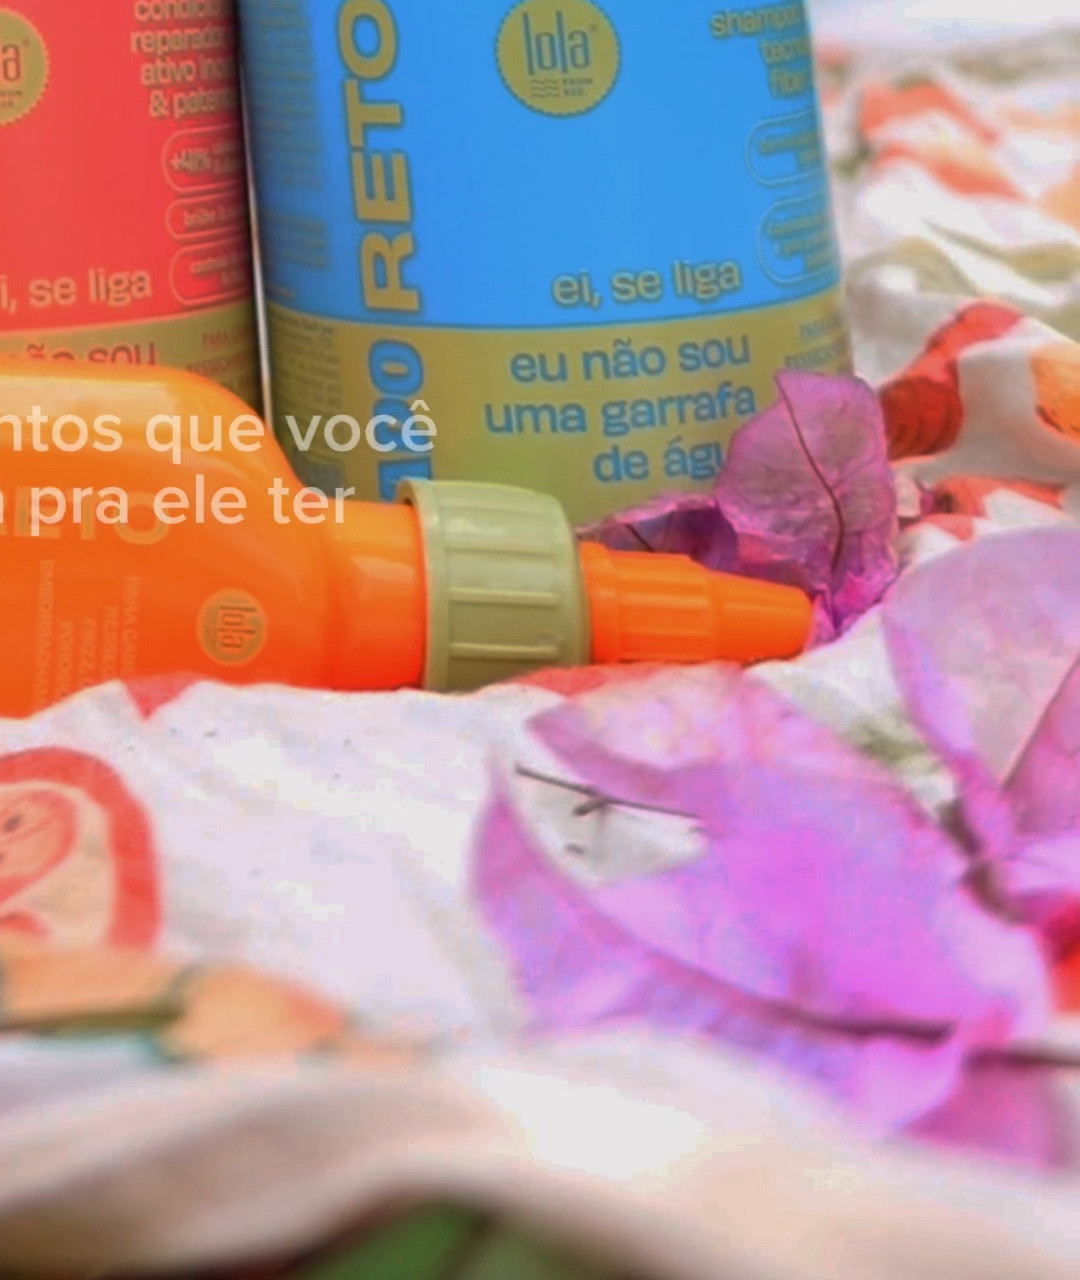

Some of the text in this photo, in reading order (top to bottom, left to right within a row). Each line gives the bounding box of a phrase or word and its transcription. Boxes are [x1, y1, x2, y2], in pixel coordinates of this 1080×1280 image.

[522, 10, 592, 76] lola
[141, 56, 196, 86] ativo
[150, 89, 170, 119] &
[27, 276, 77, 309] se
[87, 267, 152, 308] liga
[551, 260, 741, 311] ei, se liga
[510, 353, 567, 383] eu
[582, 338, 666, 381] não
[678, 335, 751, 372] sou
[484, 380, 757, 438] uma garrafa
[593, 444, 650, 482] de
[218, 604, 258, 648] lola
